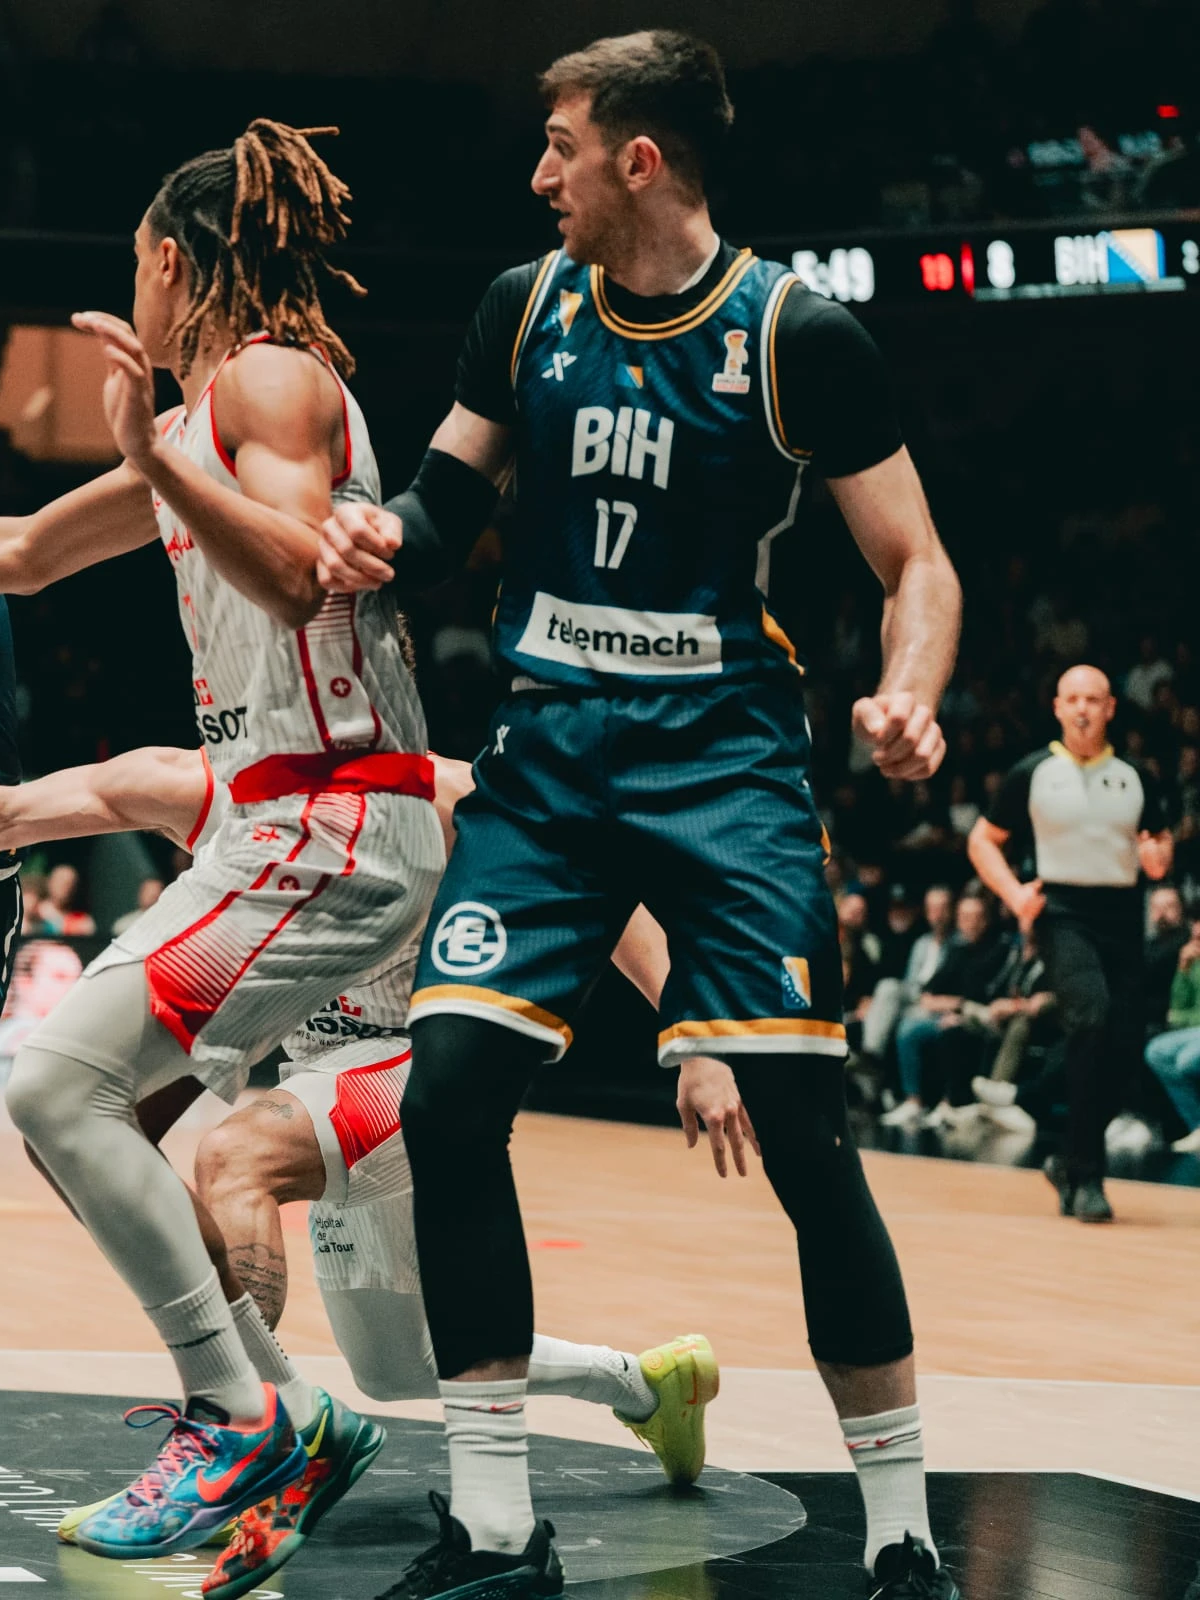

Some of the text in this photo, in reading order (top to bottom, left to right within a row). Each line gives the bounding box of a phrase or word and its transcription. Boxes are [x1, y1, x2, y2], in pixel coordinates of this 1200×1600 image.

[571, 406, 675, 490] BIH
[594, 498, 638, 570] 17
[547, 613, 699, 656] telemach
